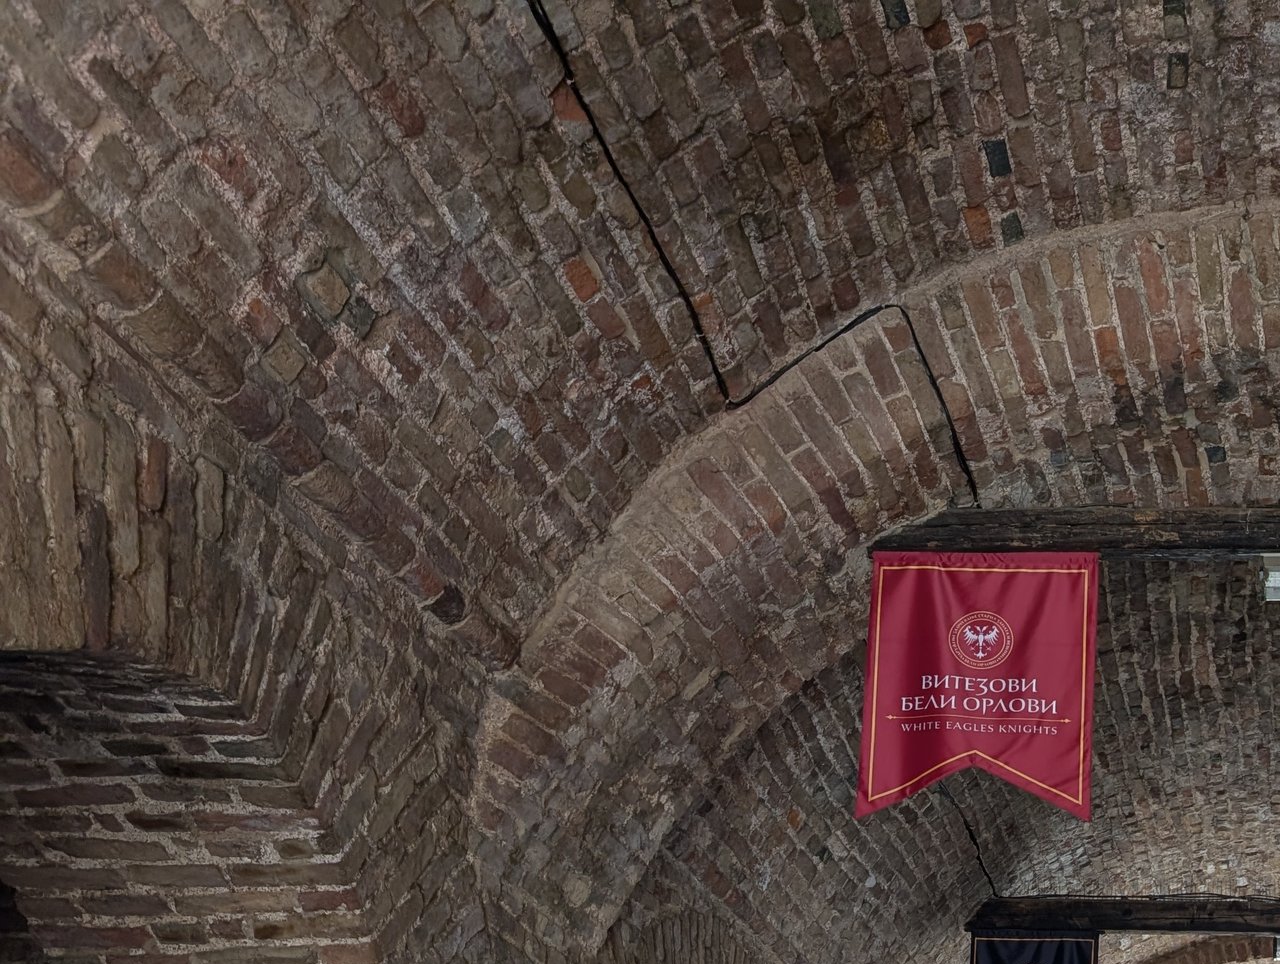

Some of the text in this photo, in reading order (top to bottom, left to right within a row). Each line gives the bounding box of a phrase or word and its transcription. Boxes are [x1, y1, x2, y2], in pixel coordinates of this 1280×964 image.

[921, 674, 1038, 695] ВИТЕЗОВИ
[901, 695, 1058, 715] БЕЛИ ОРЛОВИ
[901, 721, 1058, 735] WHITE EAGLES KNIGHTS
